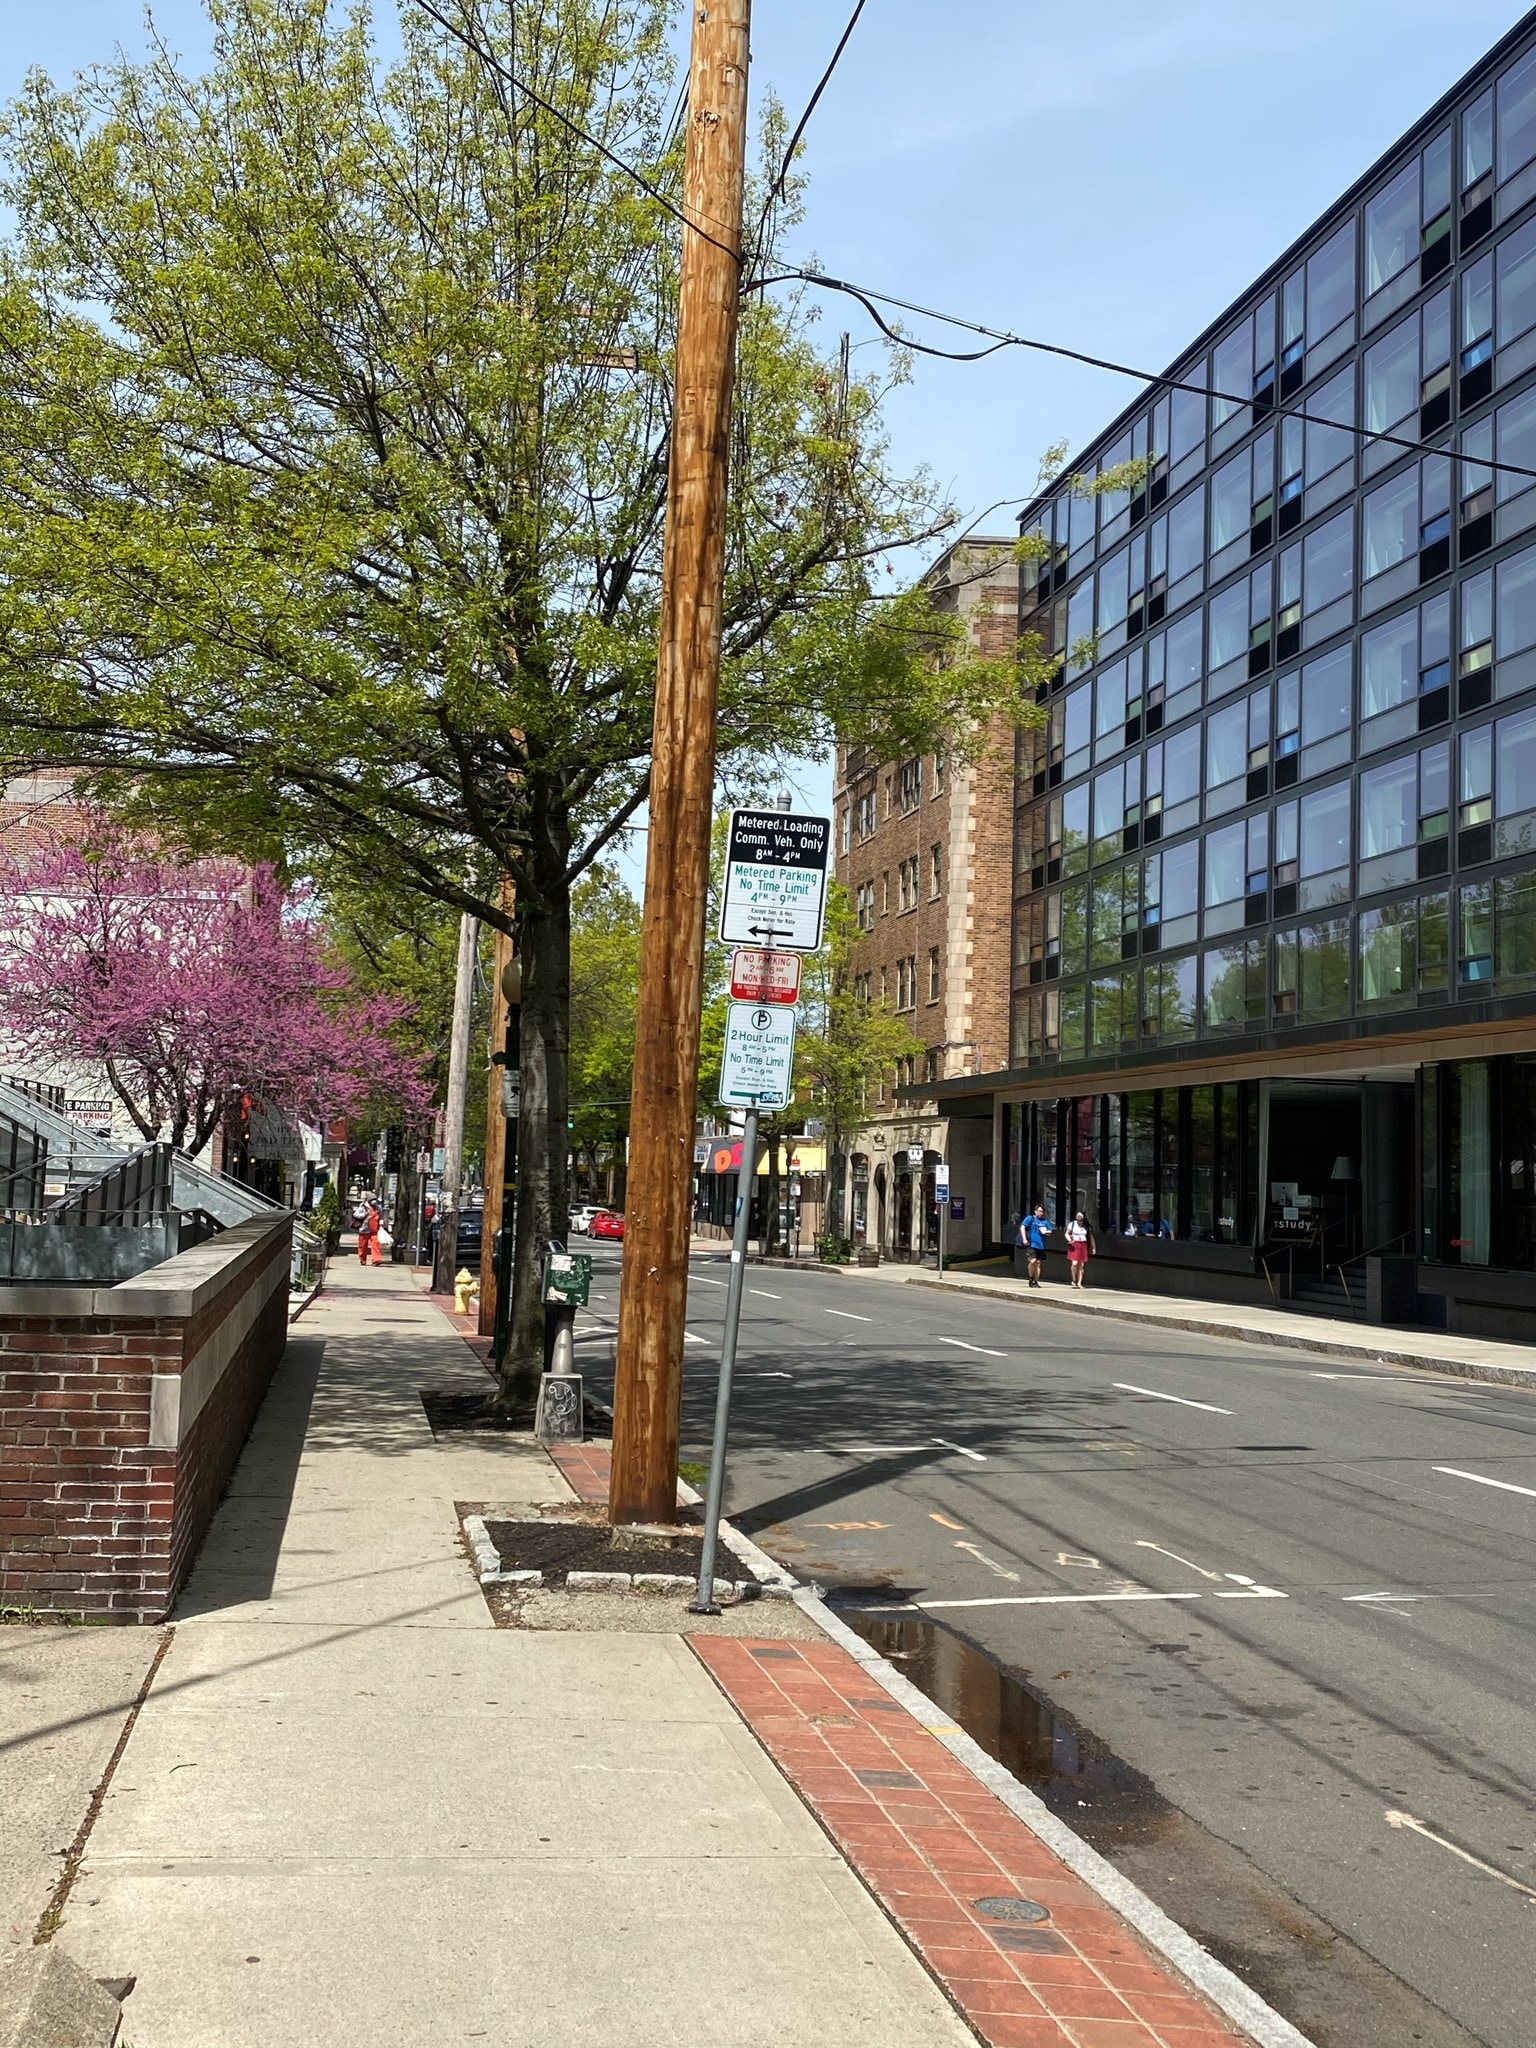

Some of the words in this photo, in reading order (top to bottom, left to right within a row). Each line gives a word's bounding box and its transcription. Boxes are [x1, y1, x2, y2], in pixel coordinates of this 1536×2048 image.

[738, 816, 780, 830] Metered
[784, 820, 824, 838] Loading
[736, 832, 770, 845] Comm.
[774, 834, 795, 847] Veh.
[800, 837, 824, 852] Only
[735, 865, 775, 878] Metered
[780, 869, 817, 886] Parking
[740, 878, 752, 889] No
[758, 880, 780, 892] Time
[785, 883, 809, 895] Limit
[744, 954, 754, 963] NO
[731, 1030, 737, 1040] 2
[739, 1031, 762, 1042] Hour
[766, 1034, 789, 1045] Limit
[730, 1053, 741, 1063] No
[745, 1054, 763, 1065] Time
[766, 1056, 784, 1067] Limit
[75, 1102, 110, 1110] PARKING
[73, 1112, 108, 1120] PARKING
[1278, 1220, 1311, 1232] study
